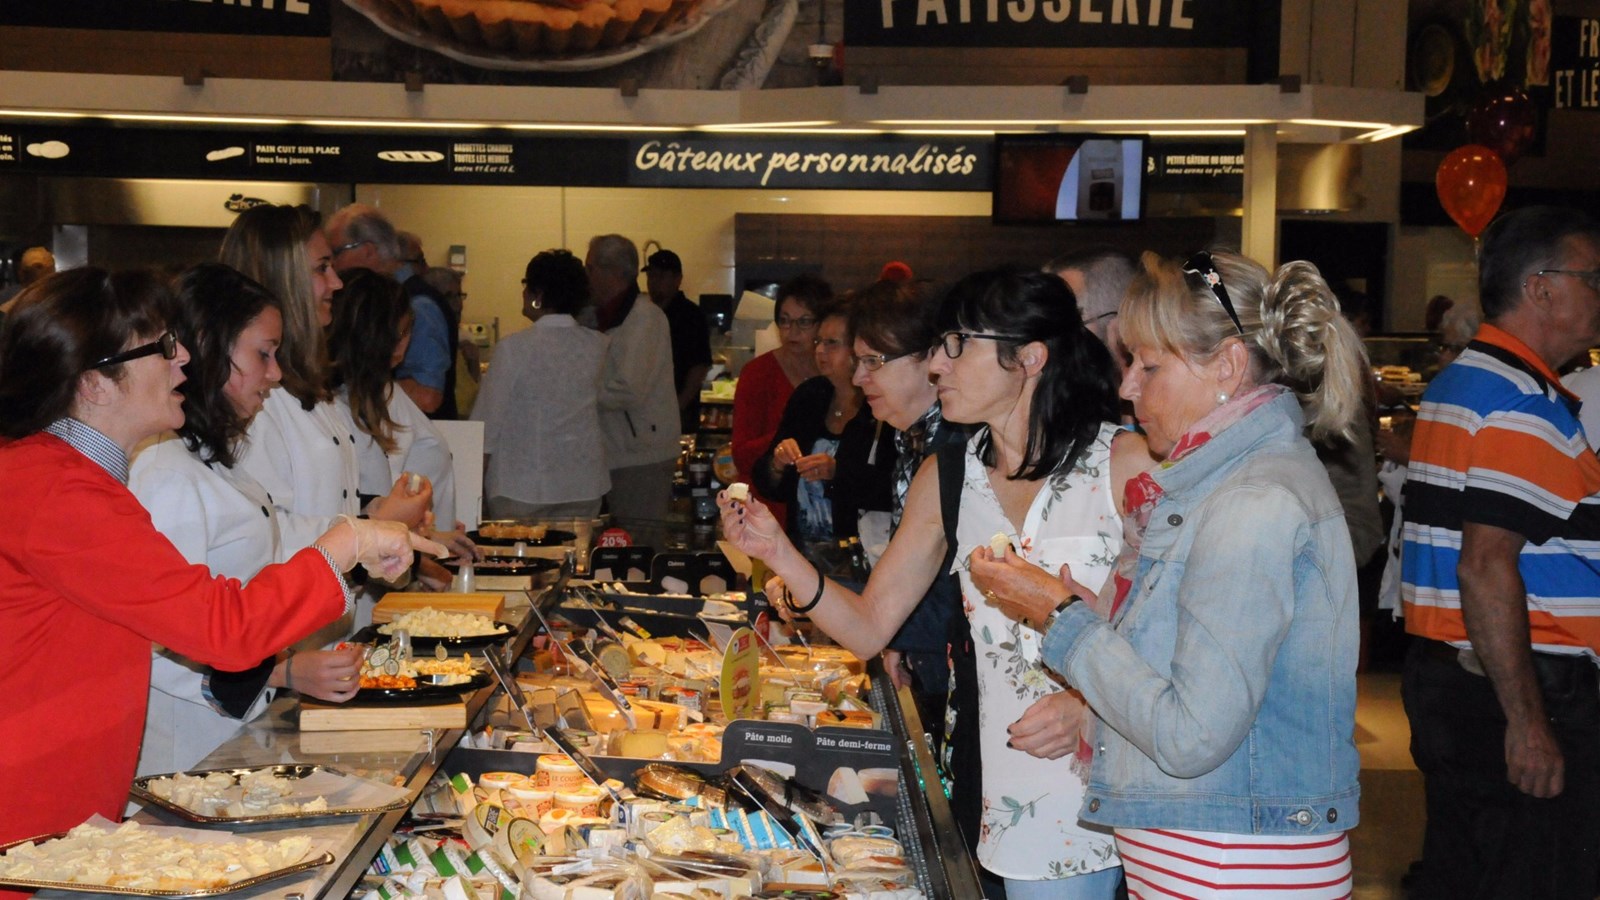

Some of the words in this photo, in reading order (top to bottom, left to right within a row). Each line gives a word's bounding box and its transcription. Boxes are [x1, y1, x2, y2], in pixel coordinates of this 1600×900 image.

[1580, 19, 1600, 58] FR
[1555, 69, 1575, 109] ET
[1581, 62, 1600, 107] LÉ
[255, 144, 276, 153] PAIN
[277, 145, 297, 153] CUIT
[297, 146, 315, 154] SUR
[315, 146, 340, 155] PLACE
[256, 155, 275, 163] tous
[276, 155, 288, 164] les
[289, 156, 312, 166] jours.
[453, 154, 475, 164] TOUTES
[476, 154, 487, 164] LES
[635, 141, 763, 173] Gâteaux
[759, 145, 977, 187] personnalisés
[1166, 155, 1186, 165] PETITE
[602, 536, 628, 547] 20%
[744, 731, 765, 743] Pâte
[766, 733, 793, 744] molle
[816, 736, 836, 747] Pâte
[838, 738, 892, 751] demi-ferme
